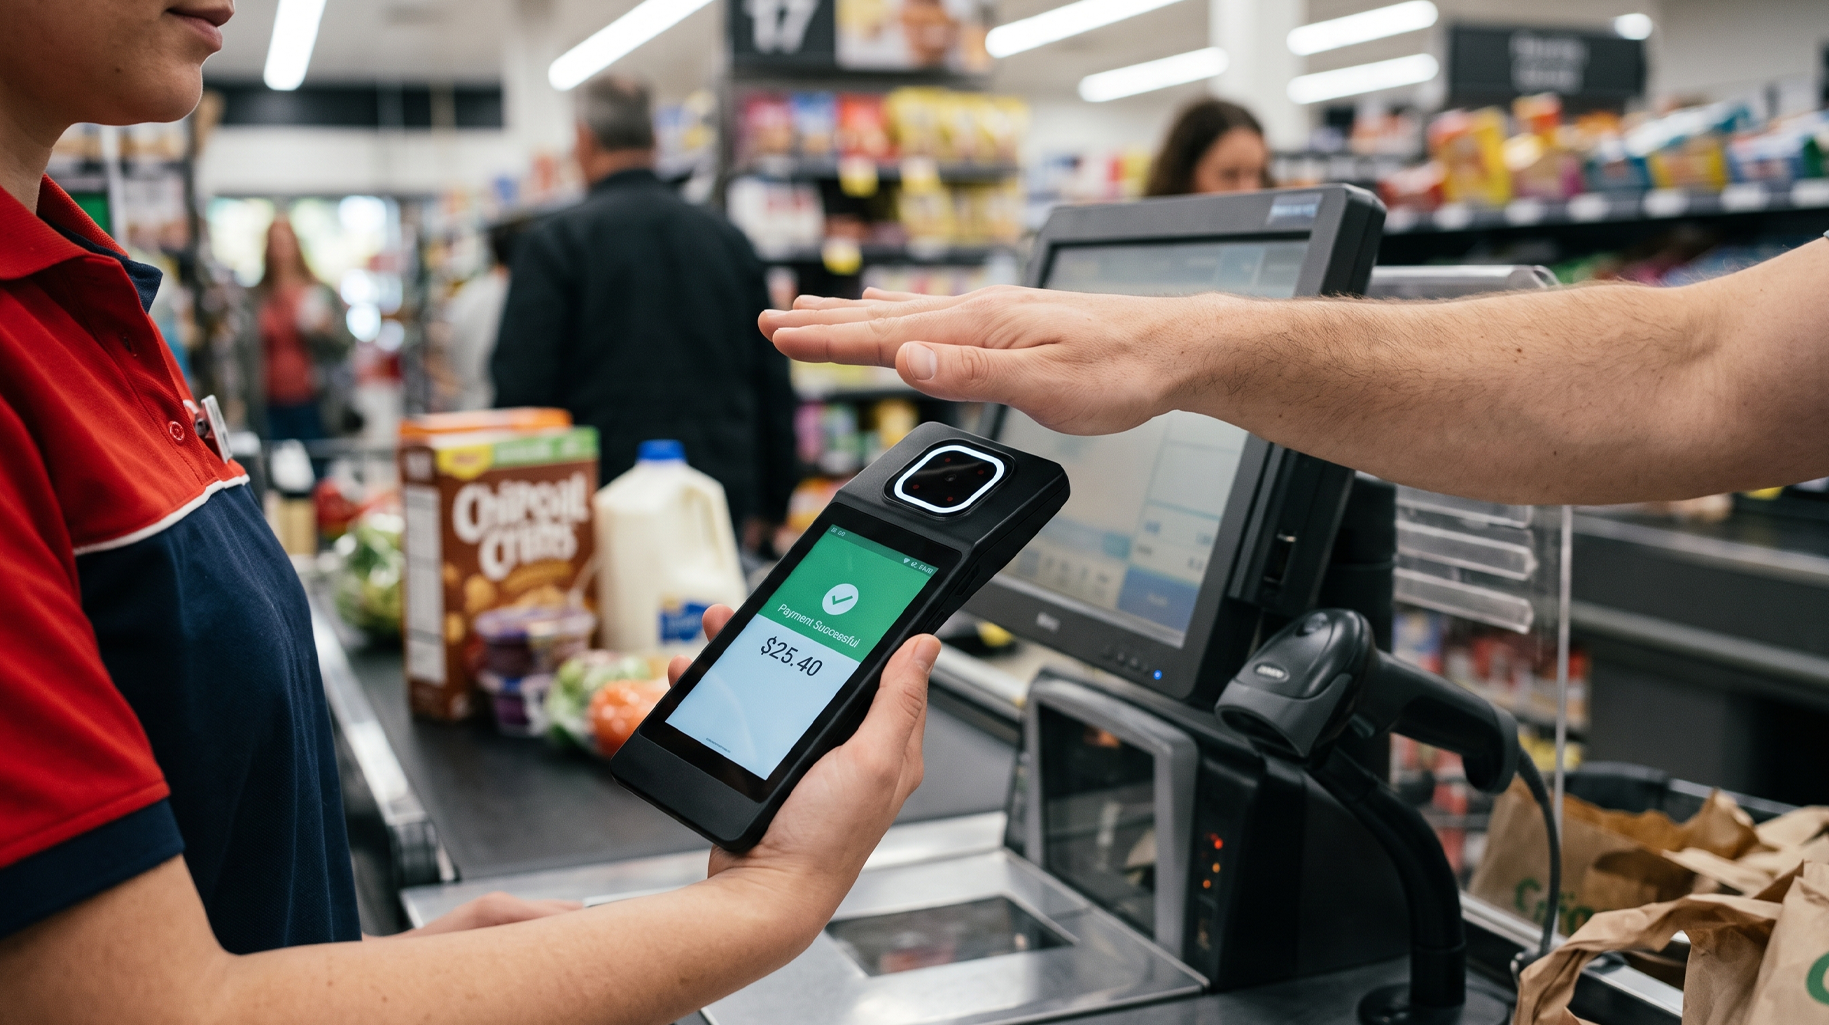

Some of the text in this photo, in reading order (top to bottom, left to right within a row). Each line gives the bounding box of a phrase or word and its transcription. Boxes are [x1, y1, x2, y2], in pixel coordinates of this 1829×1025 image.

[777, 603, 861, 648] Payment Successful
[760, 636, 823, 677] $25.40
